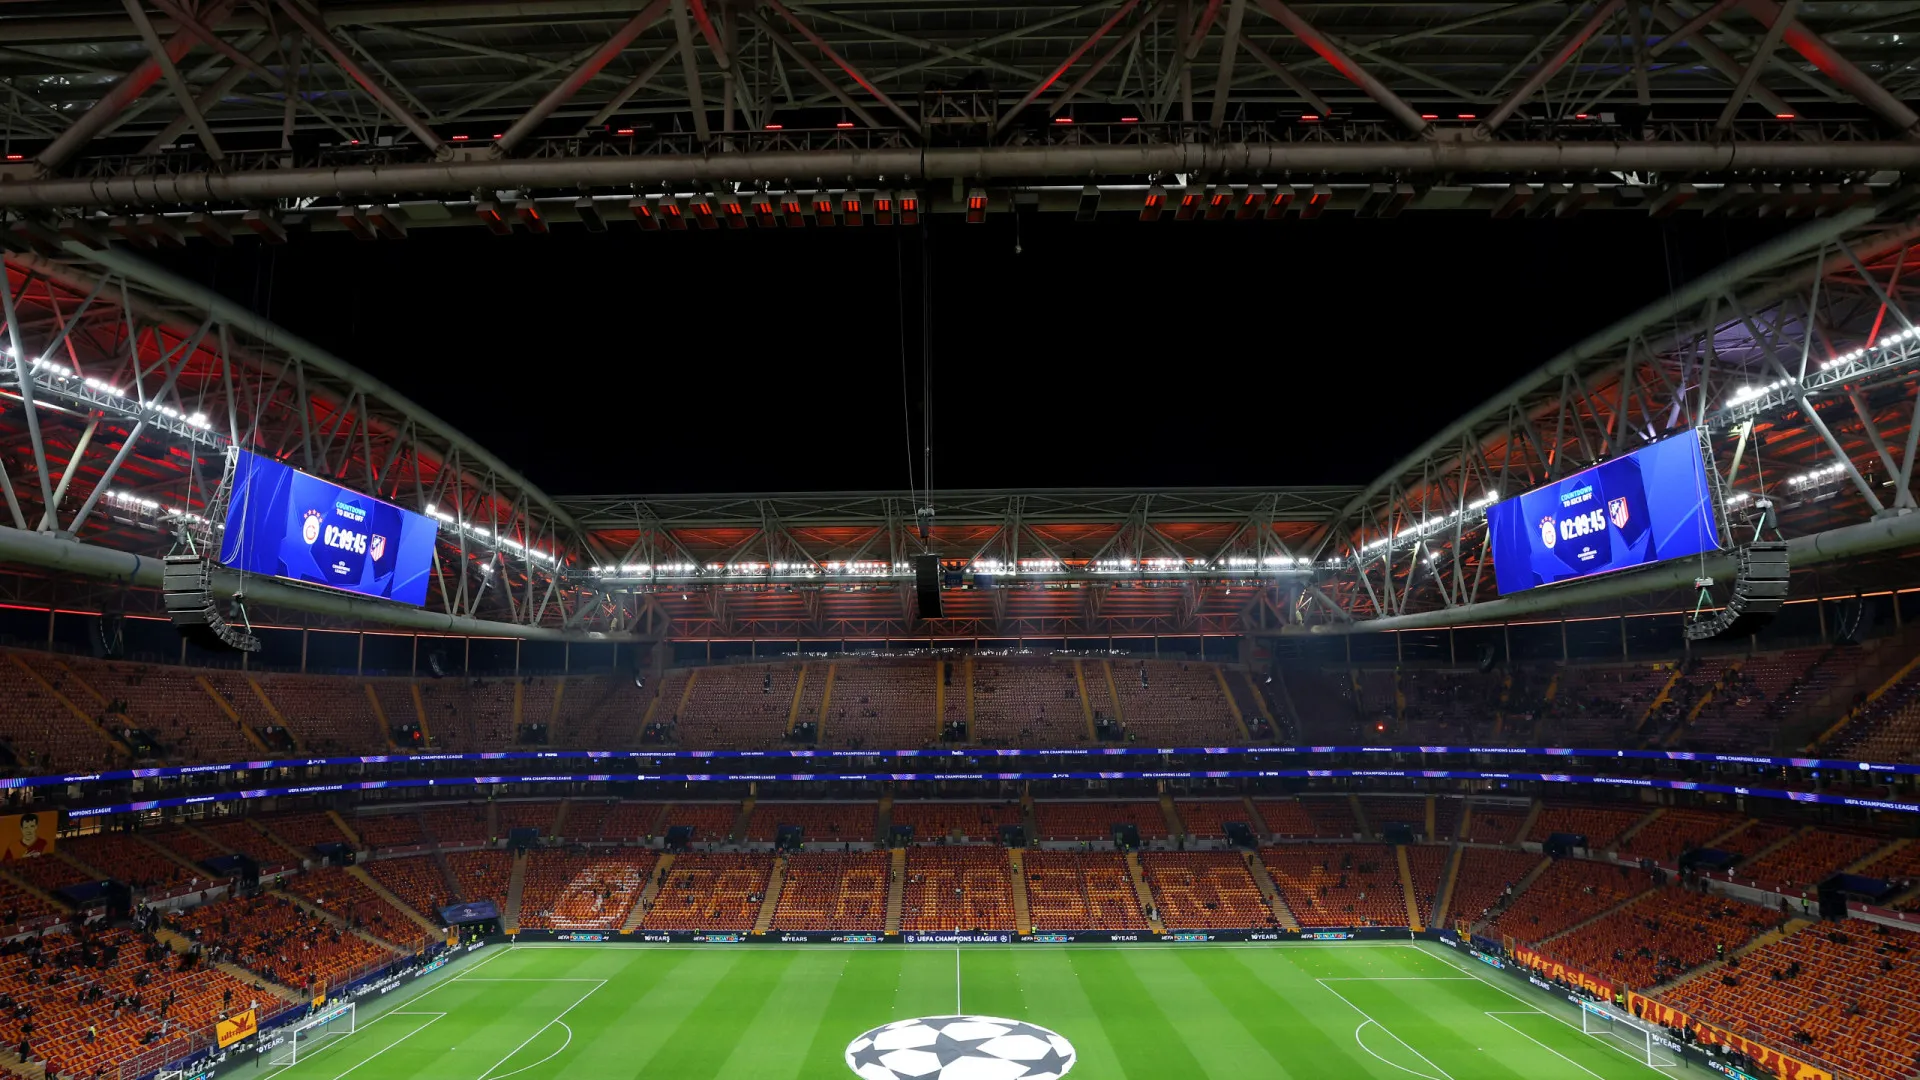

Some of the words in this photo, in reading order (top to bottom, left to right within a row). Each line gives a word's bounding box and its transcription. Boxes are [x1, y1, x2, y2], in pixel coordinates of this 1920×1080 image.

[1561, 485, 1592, 502] COUNTDOWN
[1570, 496, 1582, 505] KICK
[1582, 492, 1592, 501] OFF
[336, 502, 366, 516] COUNTDOWN
[355, 514, 364, 522] OFF
[1560, 508, 1606, 540] 02:09:45
[324, 524, 367, 554] 02:09:45
[1860, 800, 1894, 809] CHAMPIONS
[1708, 1060, 1724, 1072] UEFA
